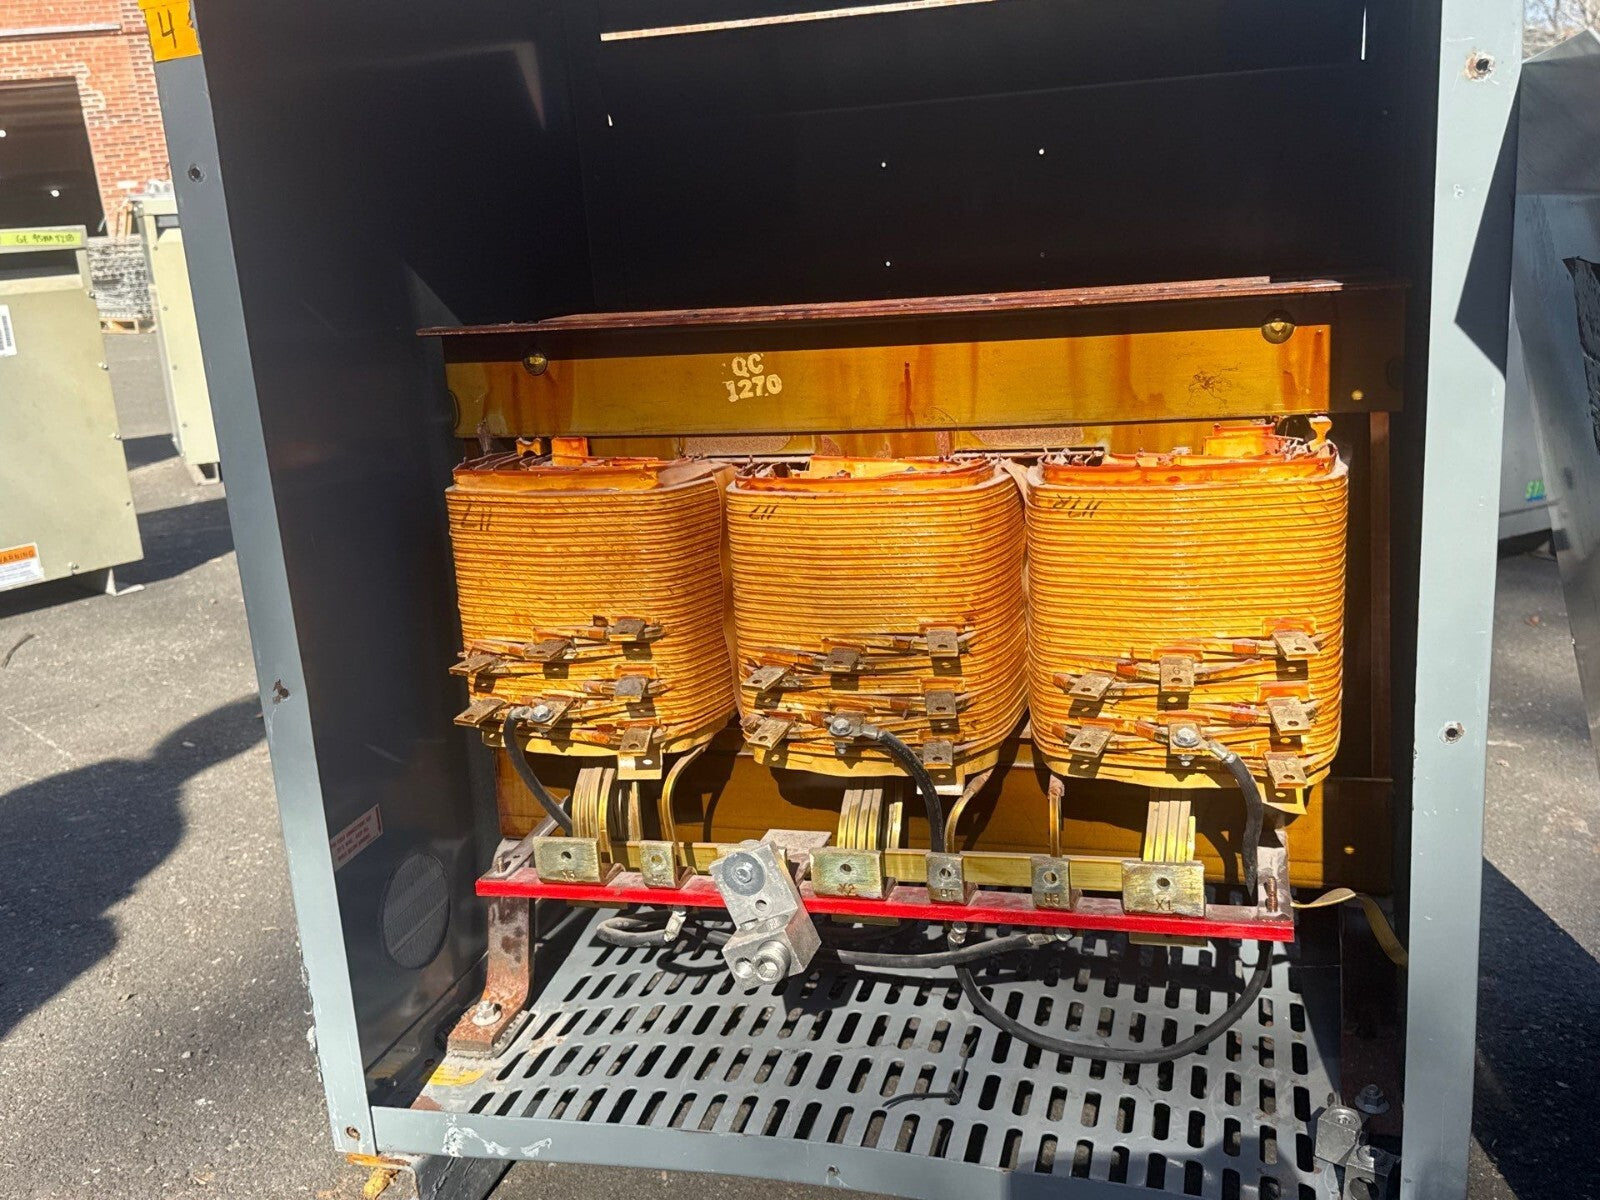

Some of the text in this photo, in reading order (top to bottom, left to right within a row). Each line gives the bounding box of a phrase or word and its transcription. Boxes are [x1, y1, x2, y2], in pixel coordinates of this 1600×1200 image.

[157, 11, 177, 48] 4
[731, 353, 764, 378] QC
[722, 374, 782, 403] 1270
[1155, 898, 1172, 911] X1
